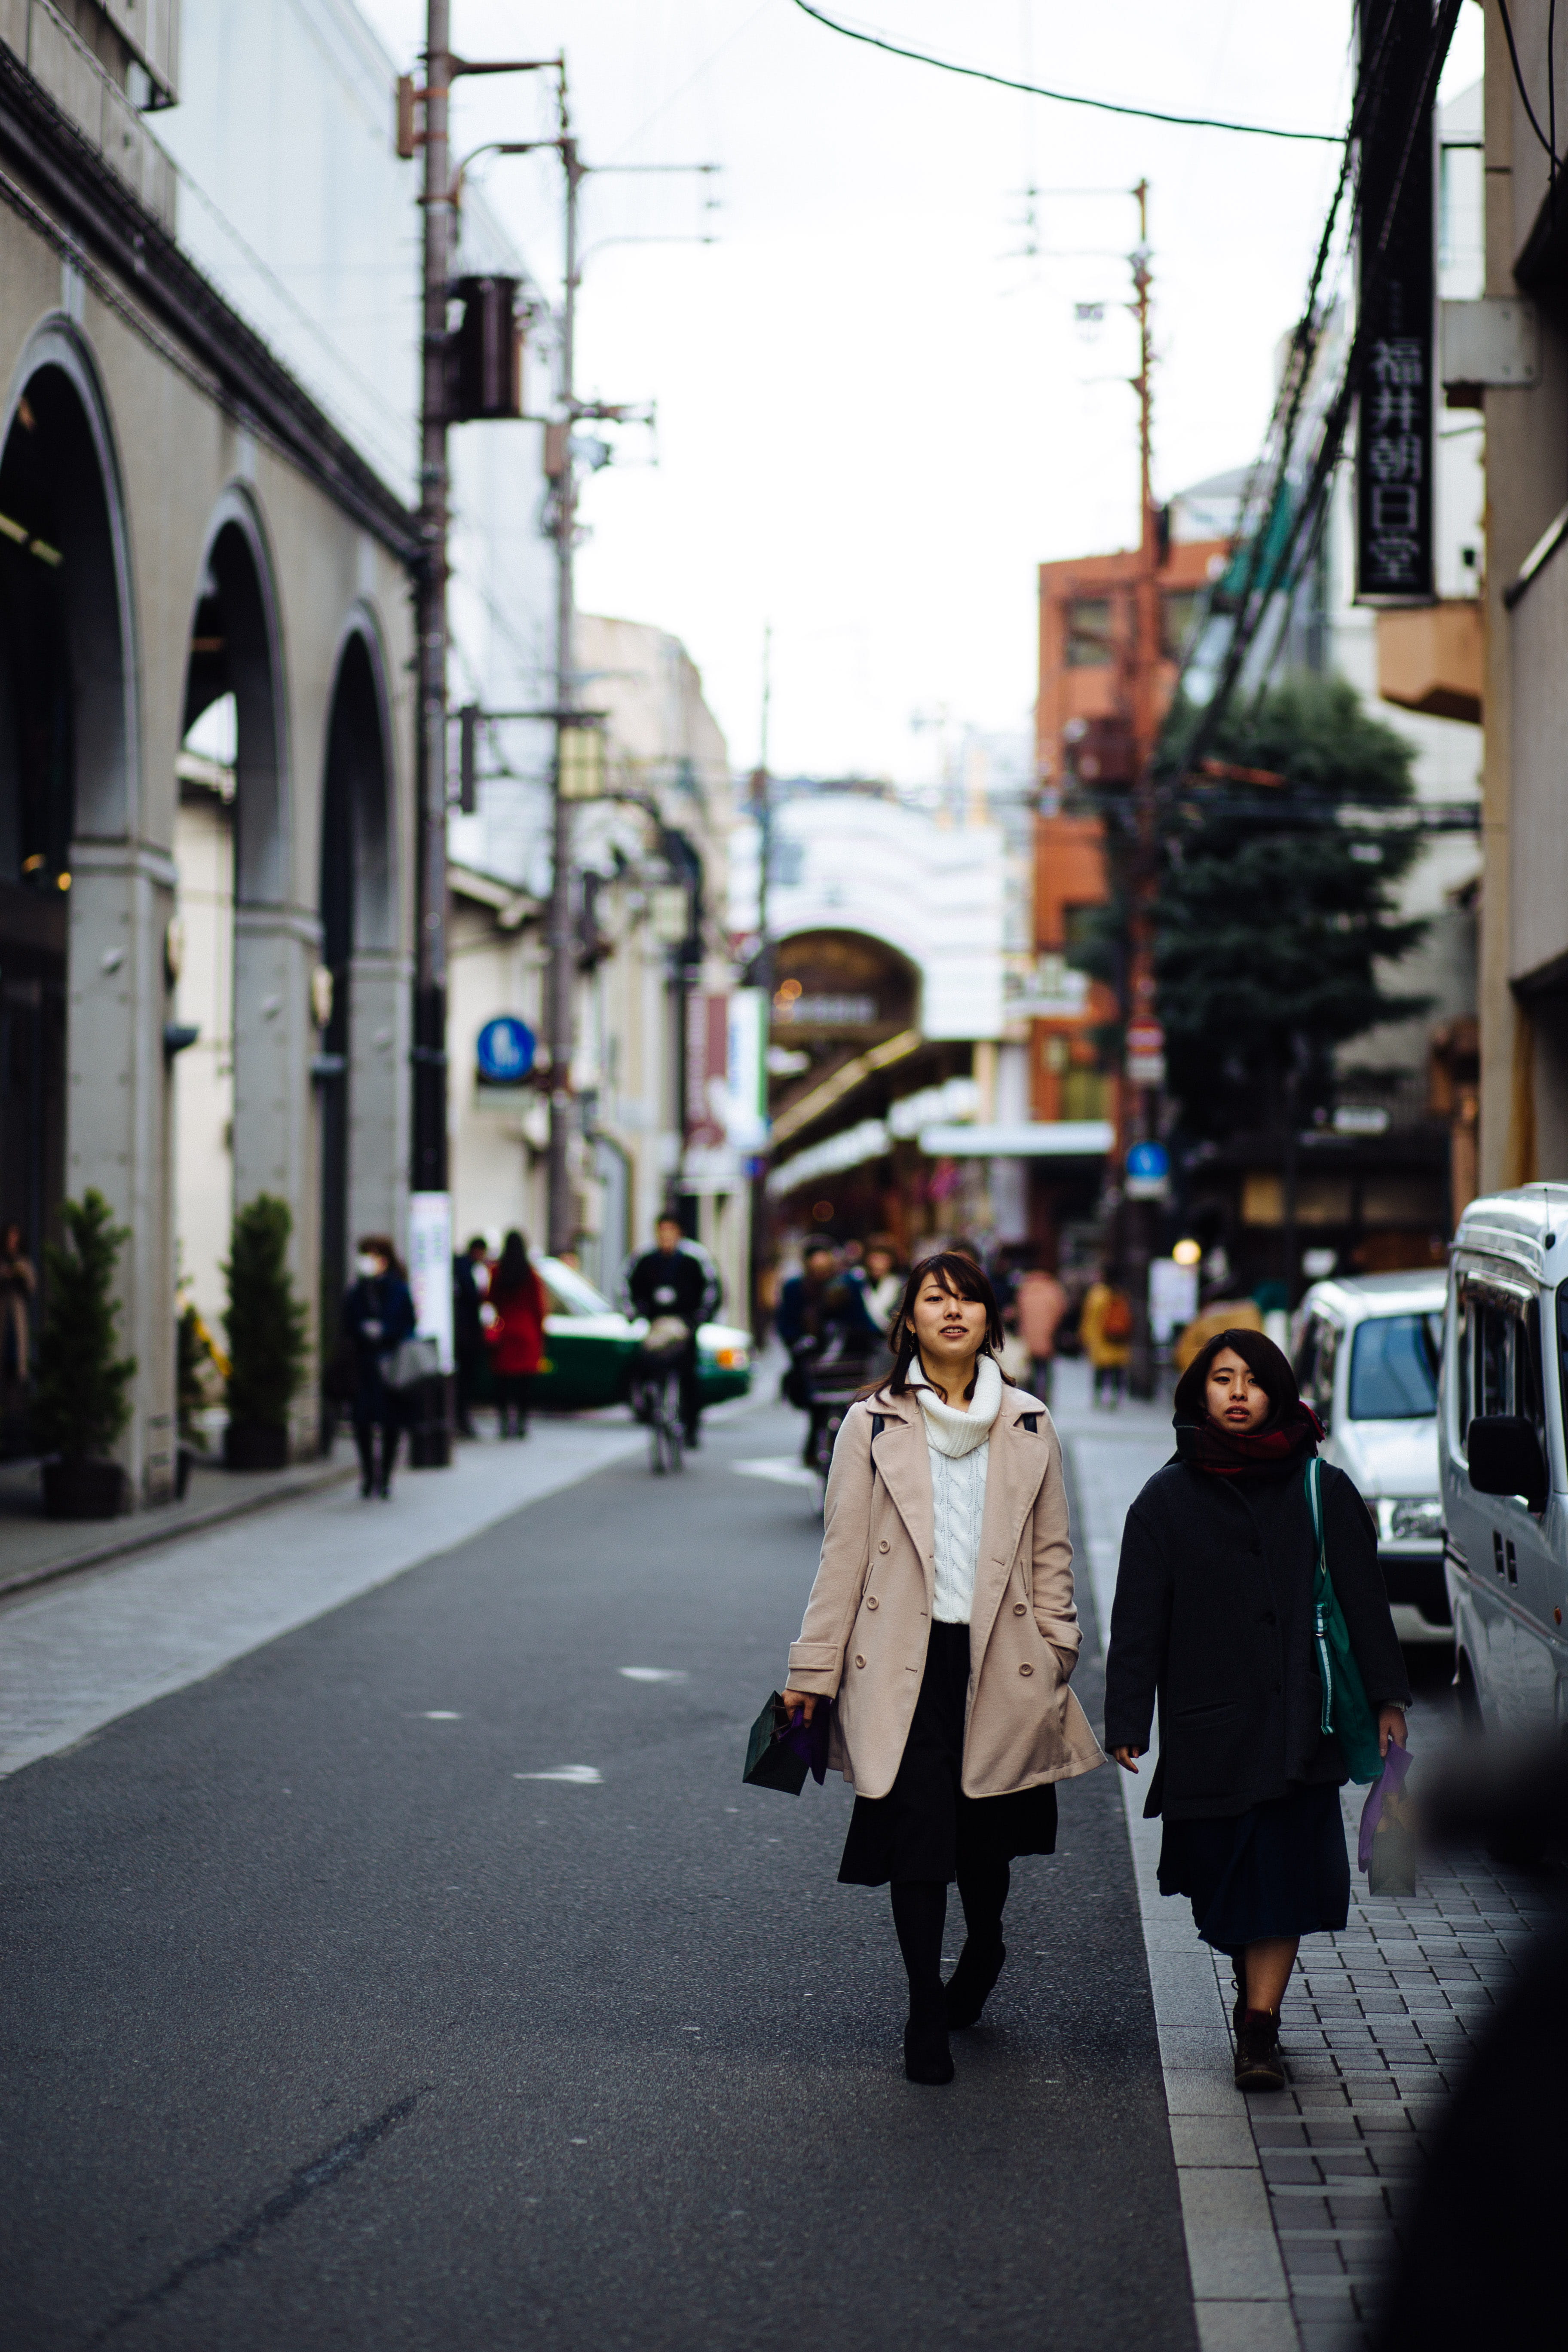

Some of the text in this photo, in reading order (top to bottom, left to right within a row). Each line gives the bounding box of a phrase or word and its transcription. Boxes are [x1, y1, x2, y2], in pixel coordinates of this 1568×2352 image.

[1370, 338, 1421, 583] 福井朝日堂
